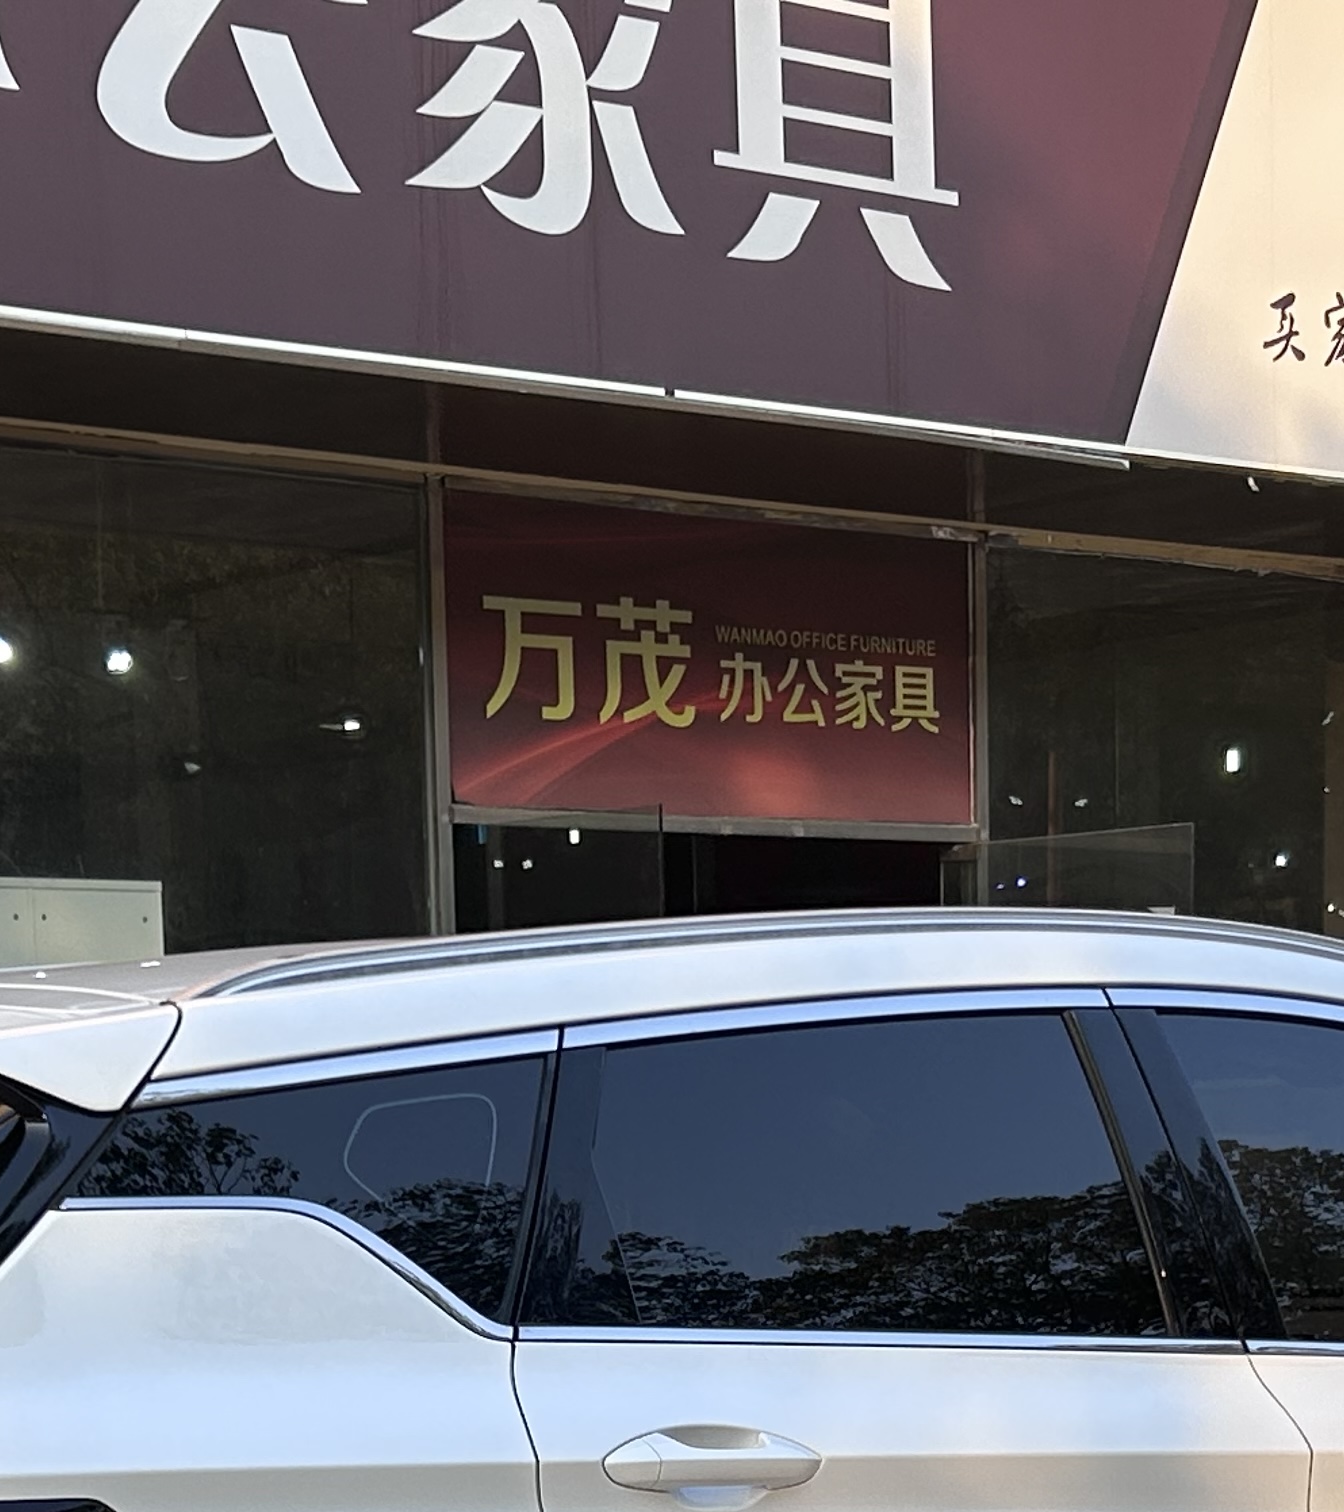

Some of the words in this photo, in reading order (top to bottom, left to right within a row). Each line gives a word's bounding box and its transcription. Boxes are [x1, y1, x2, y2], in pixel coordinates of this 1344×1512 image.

[482, 595, 696, 729] 万茂
[714, 625, 788, 648] WANMAO
[790, 630, 847, 651] OFFICE
[850, 634, 937, 657] FURNITURE
[718, 652, 940, 734] 办公家具
